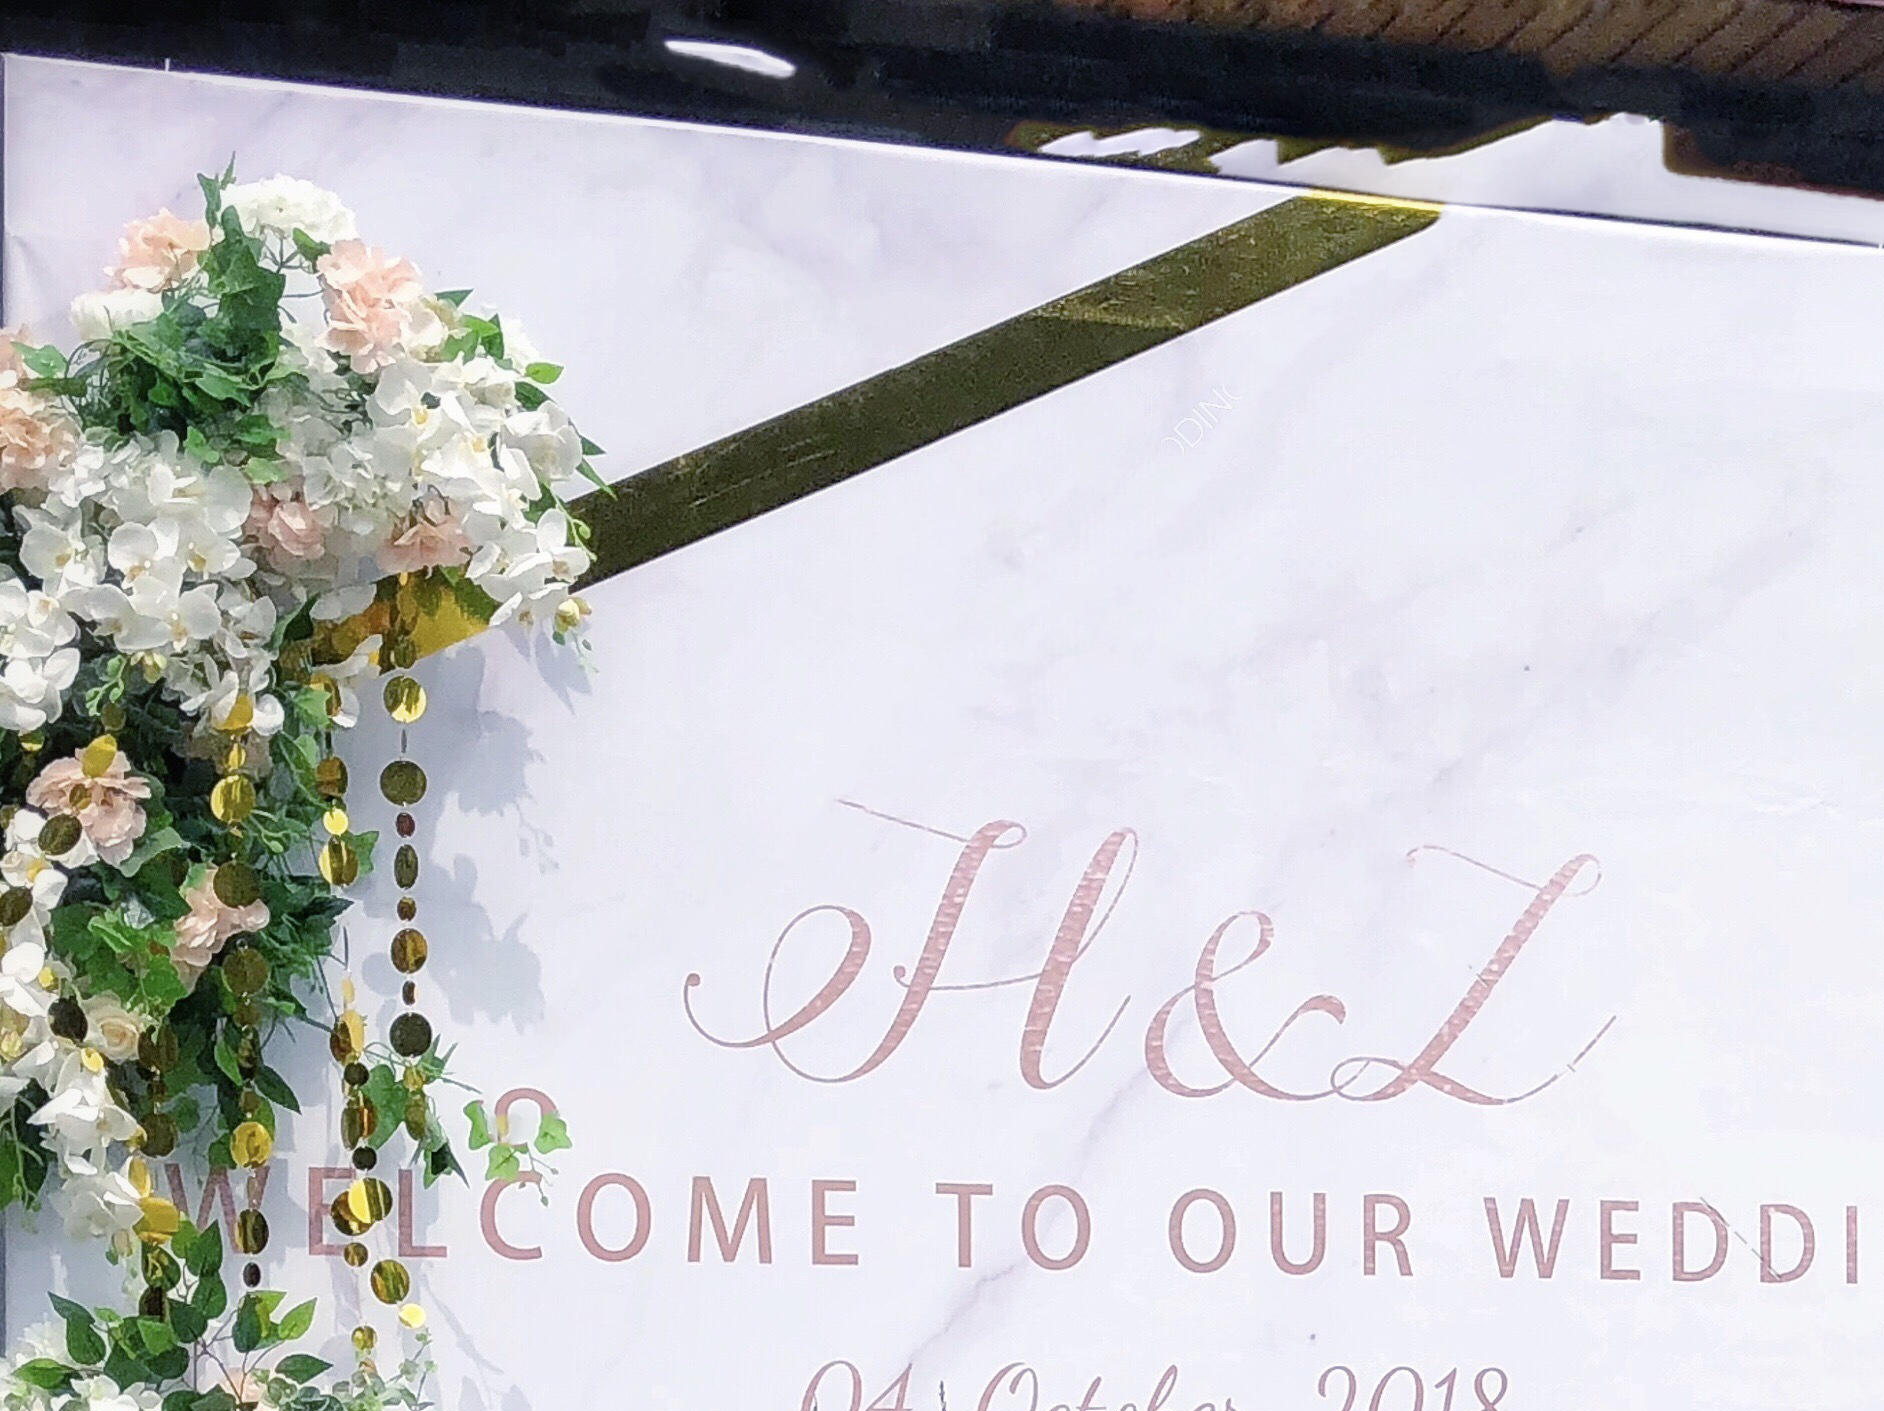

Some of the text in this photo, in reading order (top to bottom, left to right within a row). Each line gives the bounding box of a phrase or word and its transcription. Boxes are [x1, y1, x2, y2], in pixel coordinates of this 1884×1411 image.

[164, 1161, 858, 1265] WELCOME
[935, 1182, 1092, 1271] TO
[1168, 1187, 1413, 1276] OUR
